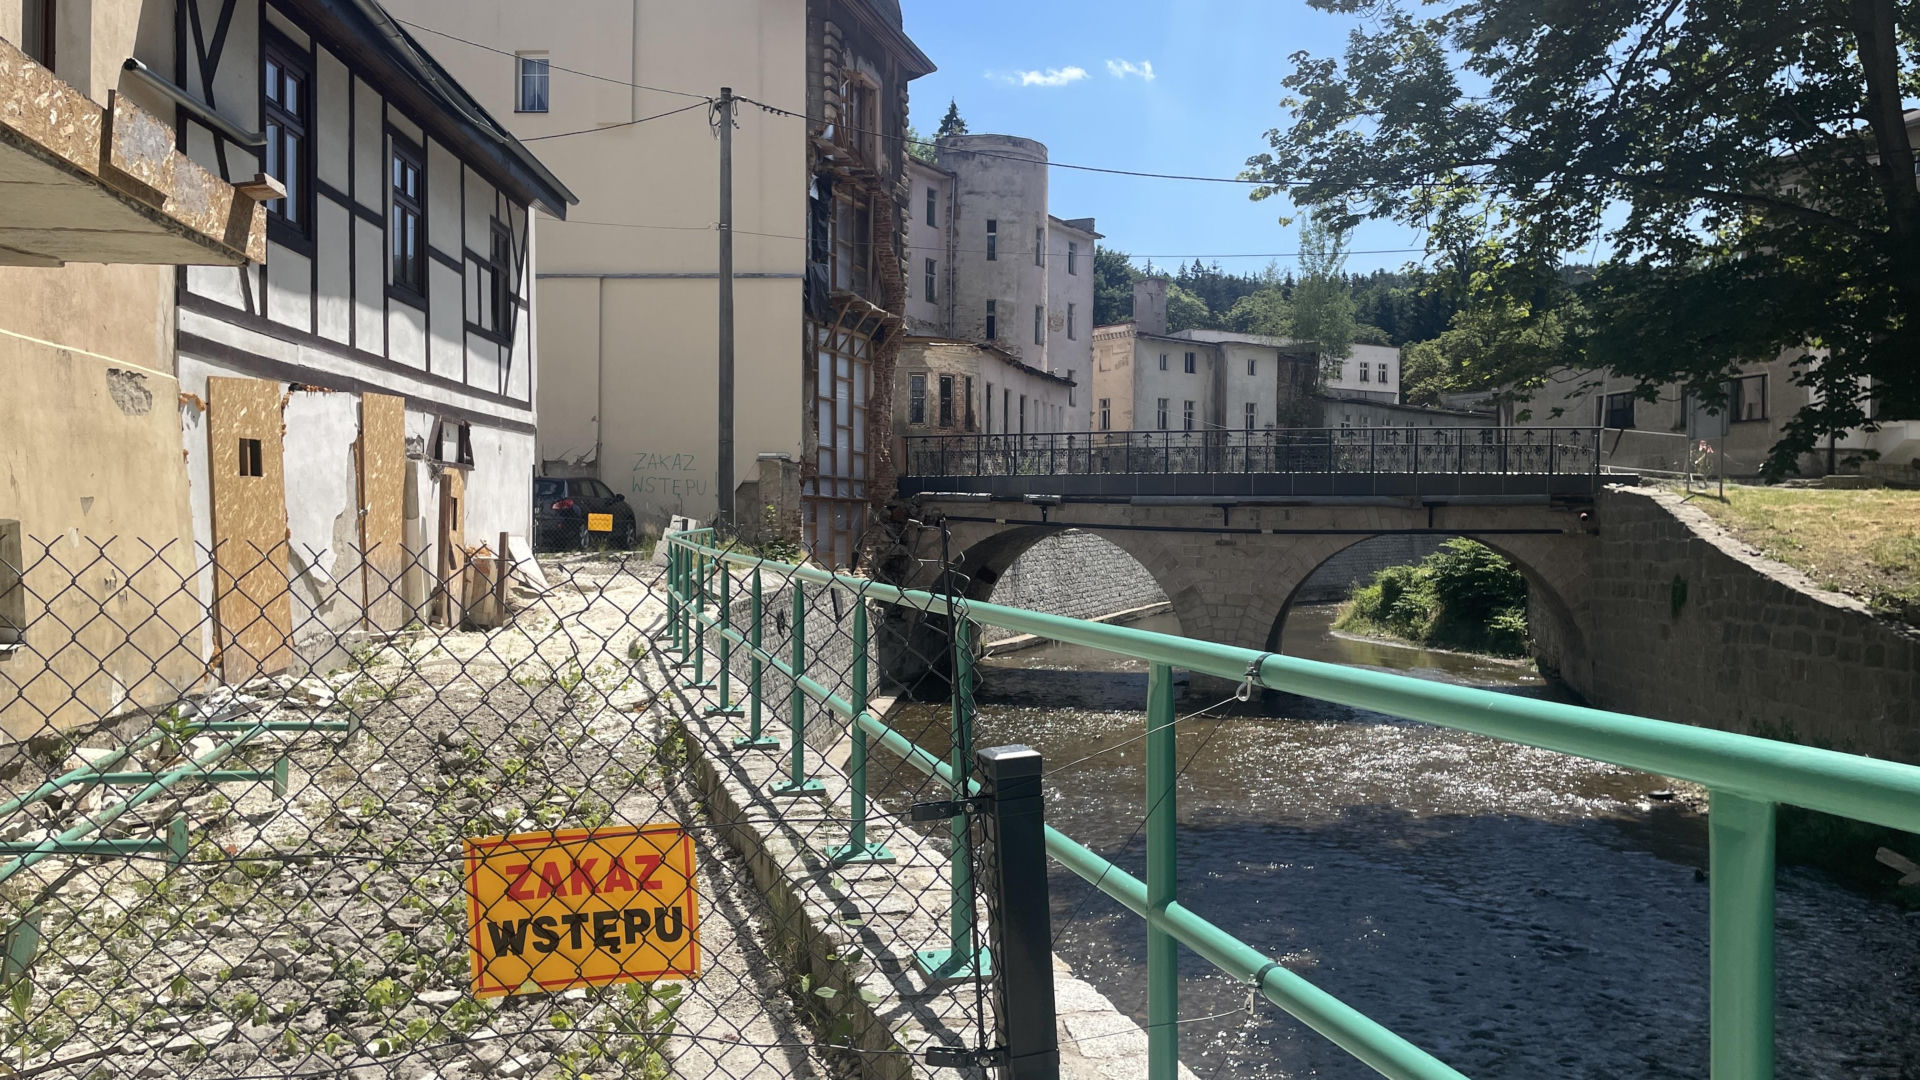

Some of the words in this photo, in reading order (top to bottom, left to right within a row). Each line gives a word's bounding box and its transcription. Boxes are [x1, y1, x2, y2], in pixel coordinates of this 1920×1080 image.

[632, 452, 697, 472] ZAKAZ
[505, 854, 663, 902] ZAKAZ
[487, 906, 684, 957] WSTĘPU
